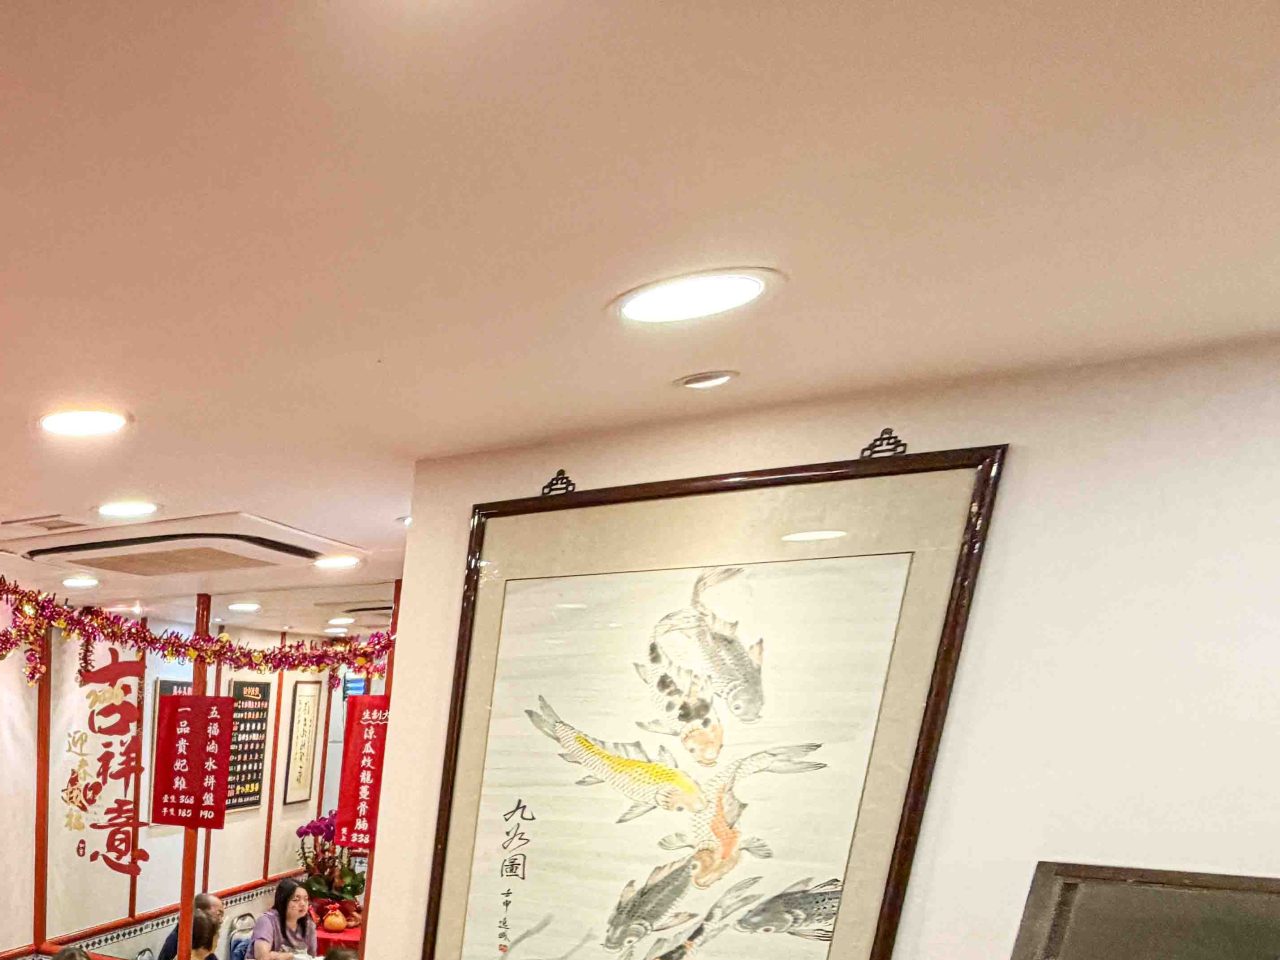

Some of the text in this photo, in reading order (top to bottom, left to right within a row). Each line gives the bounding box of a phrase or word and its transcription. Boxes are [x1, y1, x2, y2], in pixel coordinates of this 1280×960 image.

[179, 795, 194, 804] 368
[200, 810, 214, 819] 190
[351, 833, 370, 843] 338
